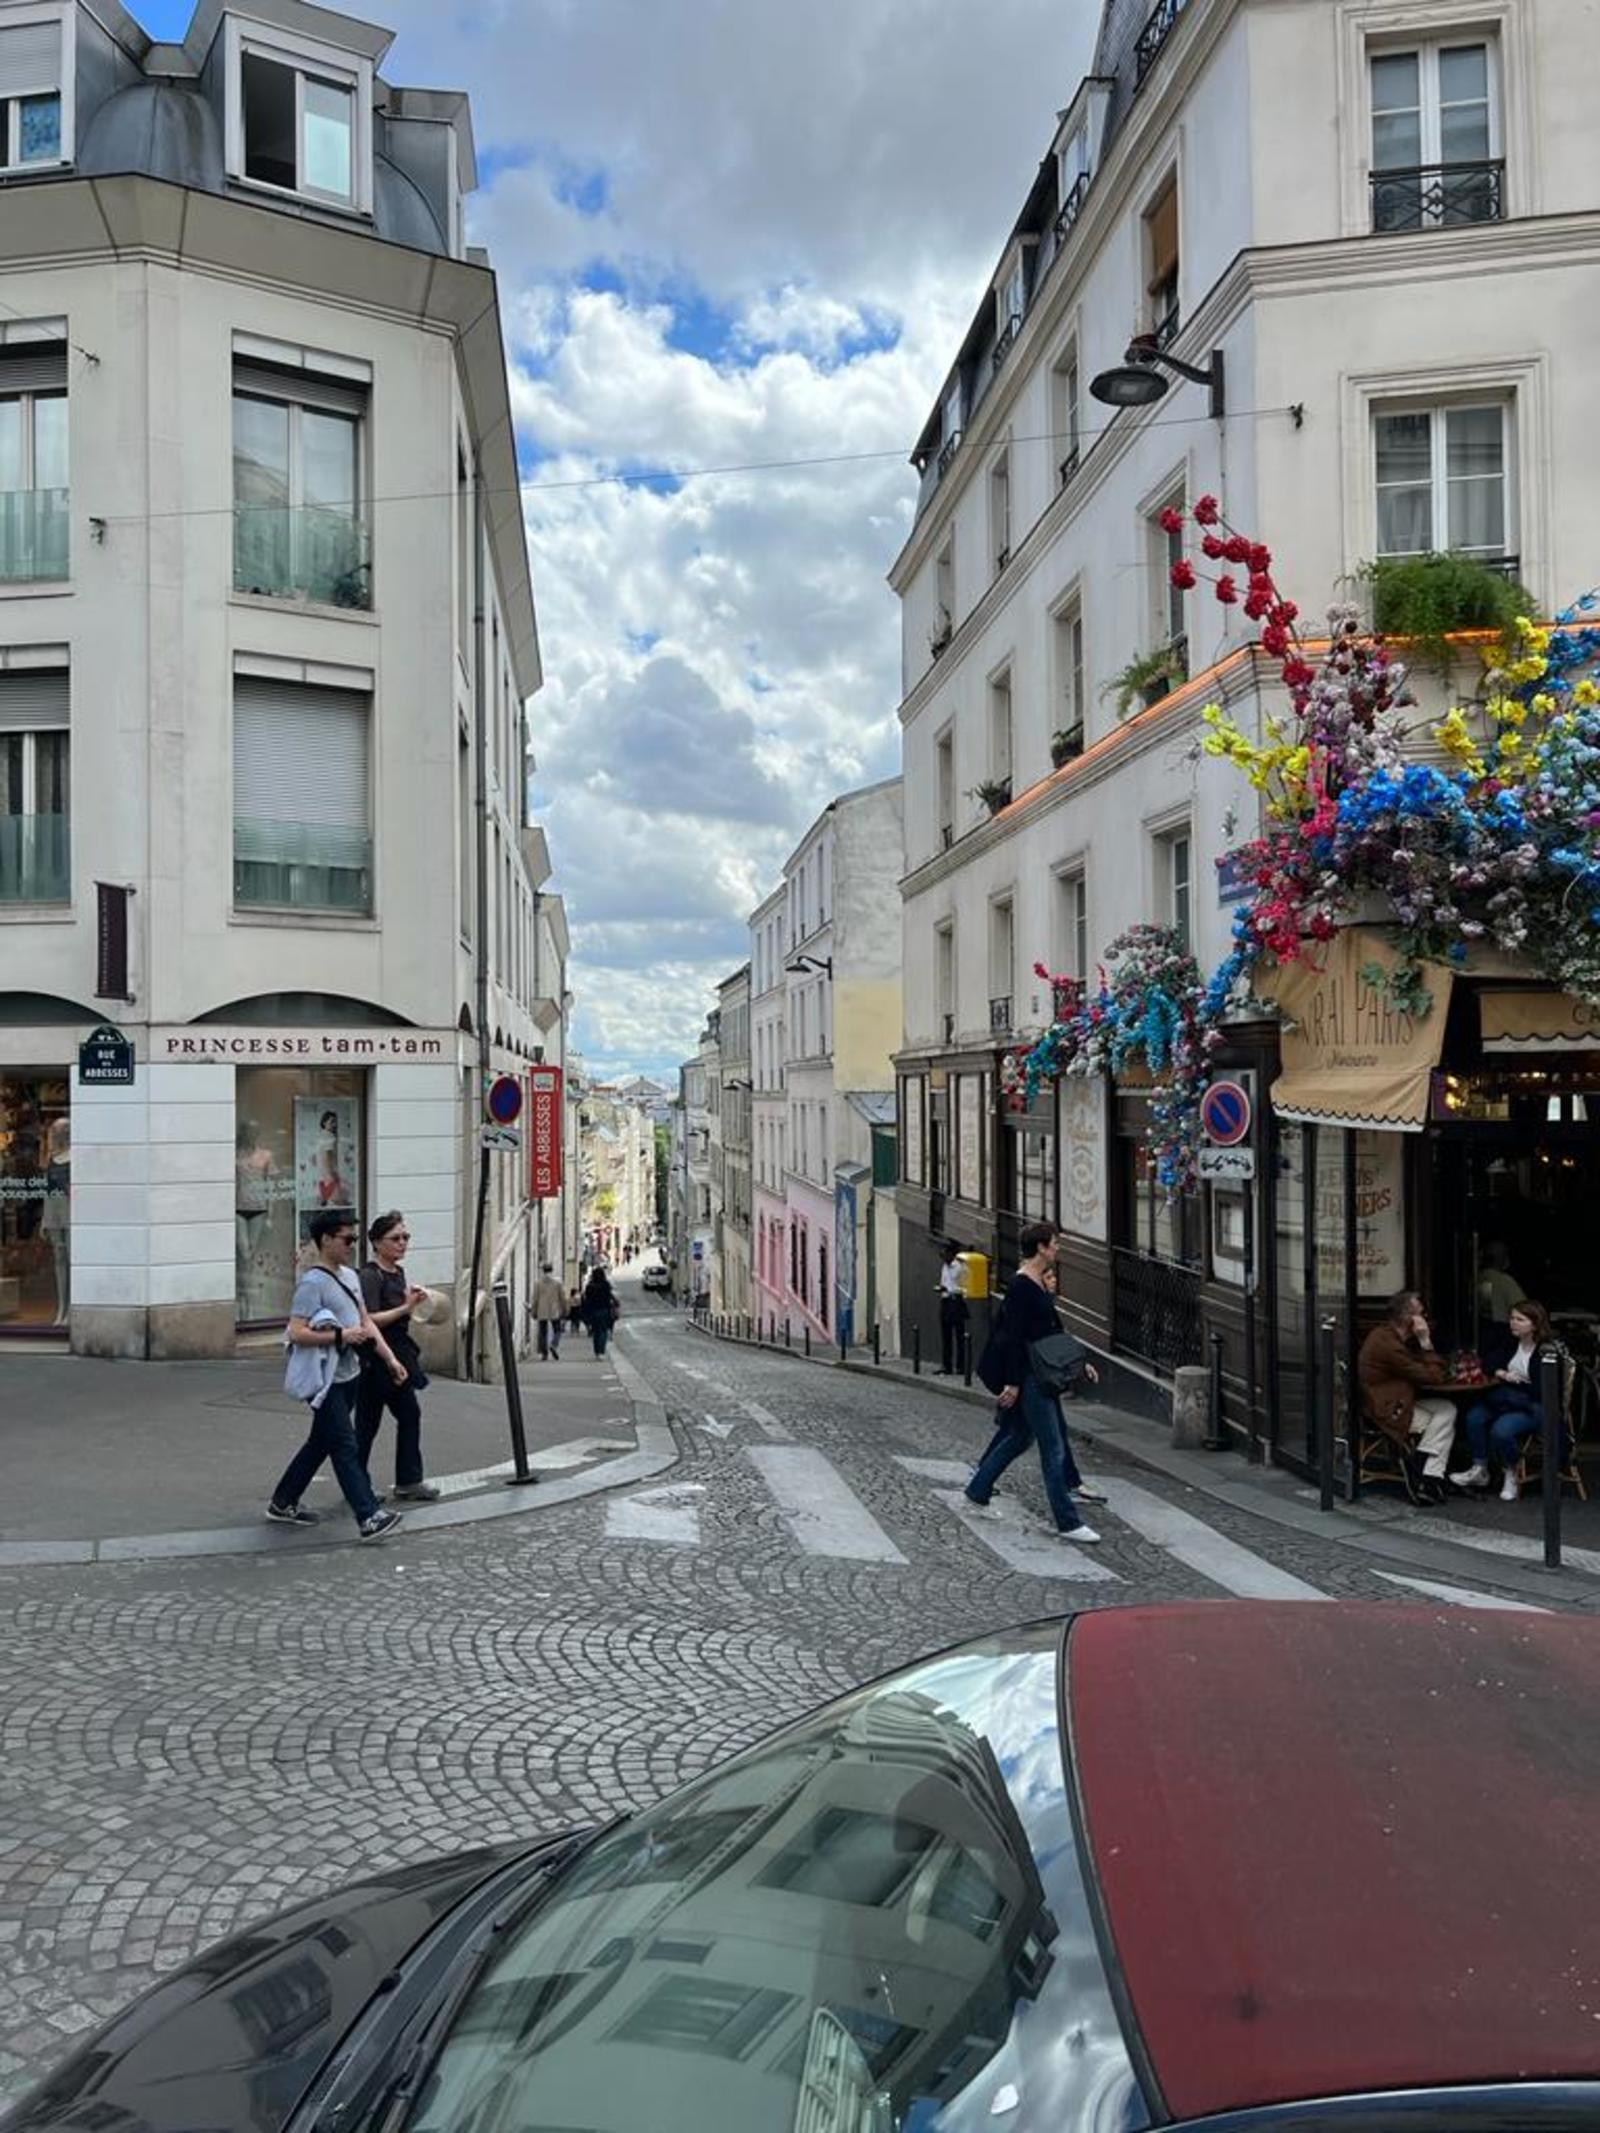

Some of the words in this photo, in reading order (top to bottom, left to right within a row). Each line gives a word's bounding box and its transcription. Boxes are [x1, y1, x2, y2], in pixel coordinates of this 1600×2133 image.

[166, 1038, 311, 1054] PRINCESSE
[97, 1049, 116, 1060] RUE
[85, 1068, 128, 1078] ABBESSES
[537, 1094, 551, 1164] ABBESSES
[537, 1166, 551, 1191] LES
